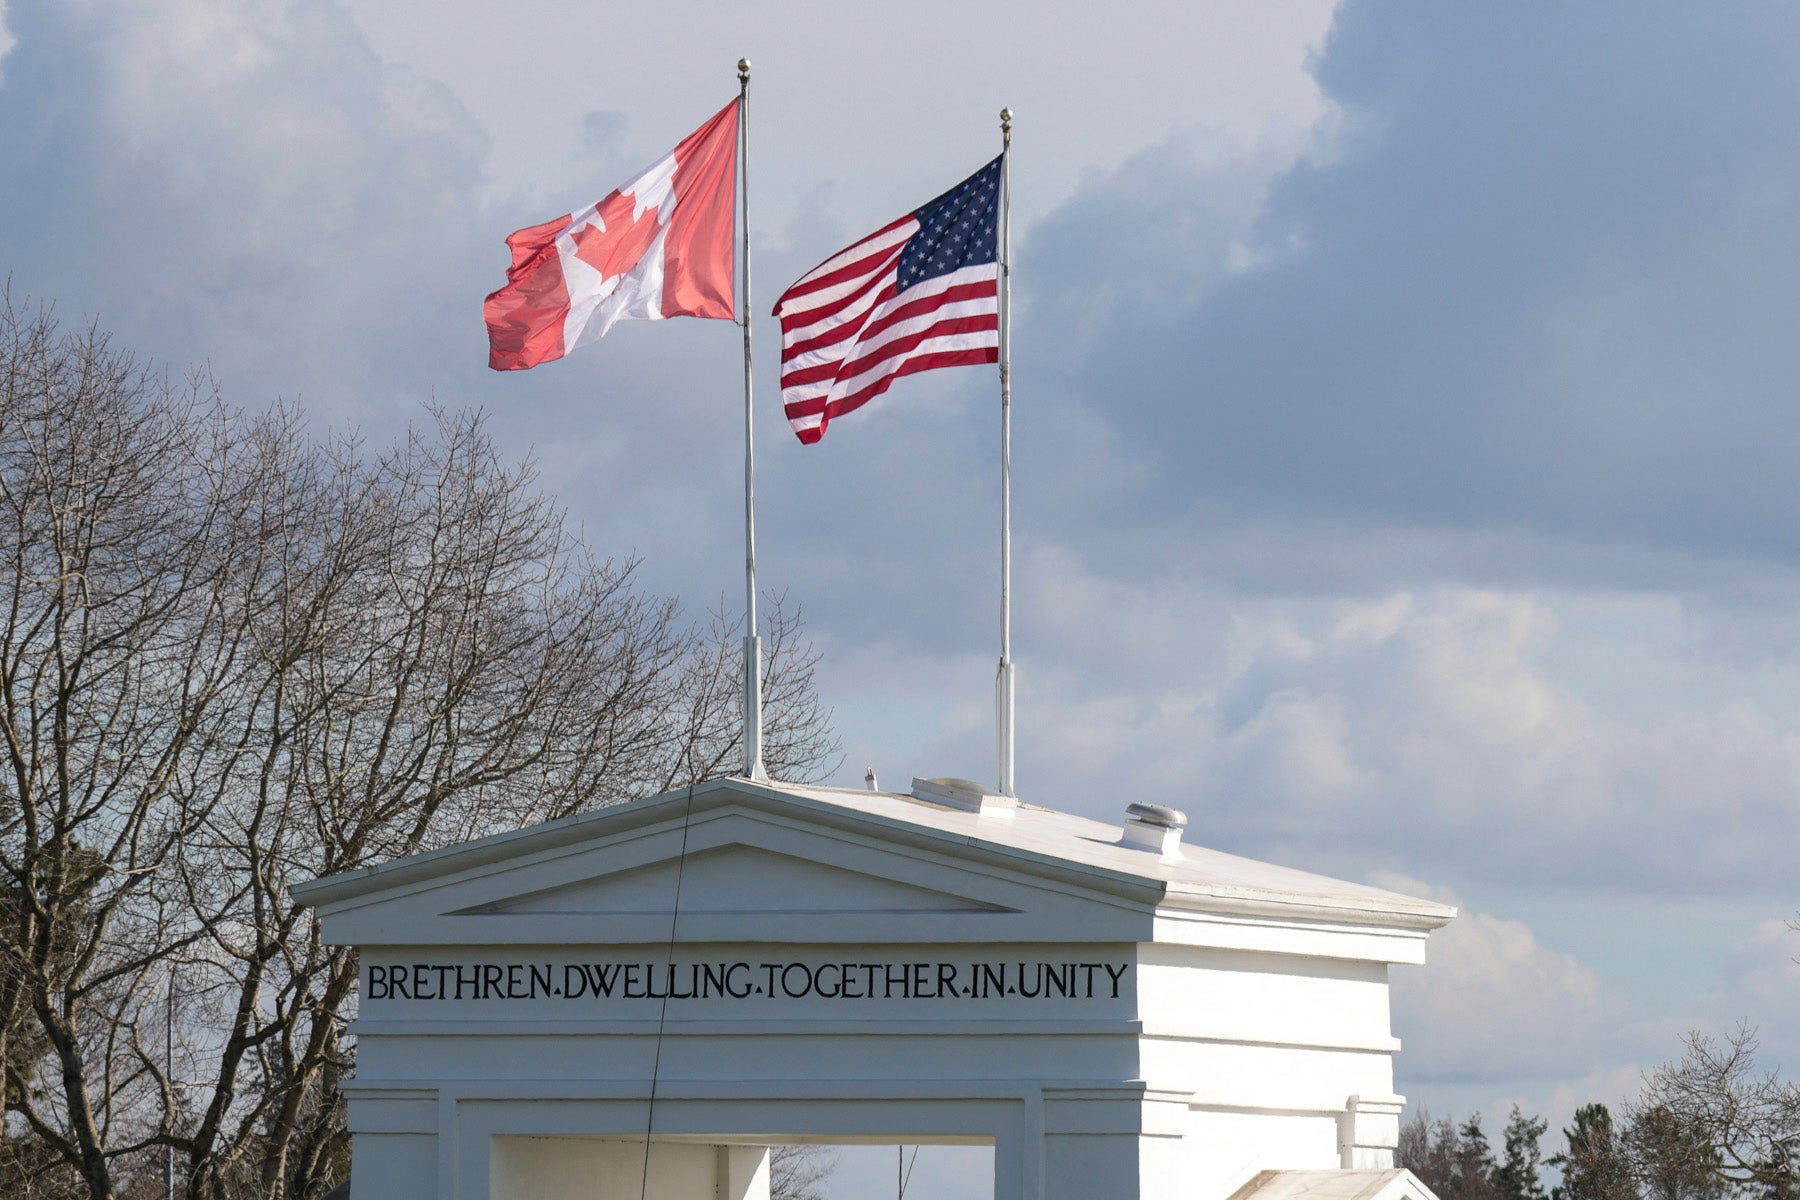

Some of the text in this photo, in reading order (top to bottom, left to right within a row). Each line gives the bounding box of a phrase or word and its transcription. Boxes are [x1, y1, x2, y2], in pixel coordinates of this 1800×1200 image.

[368, 962, 1128, 999] BRETHREN DWELLING TOGETHER IN UNITY
